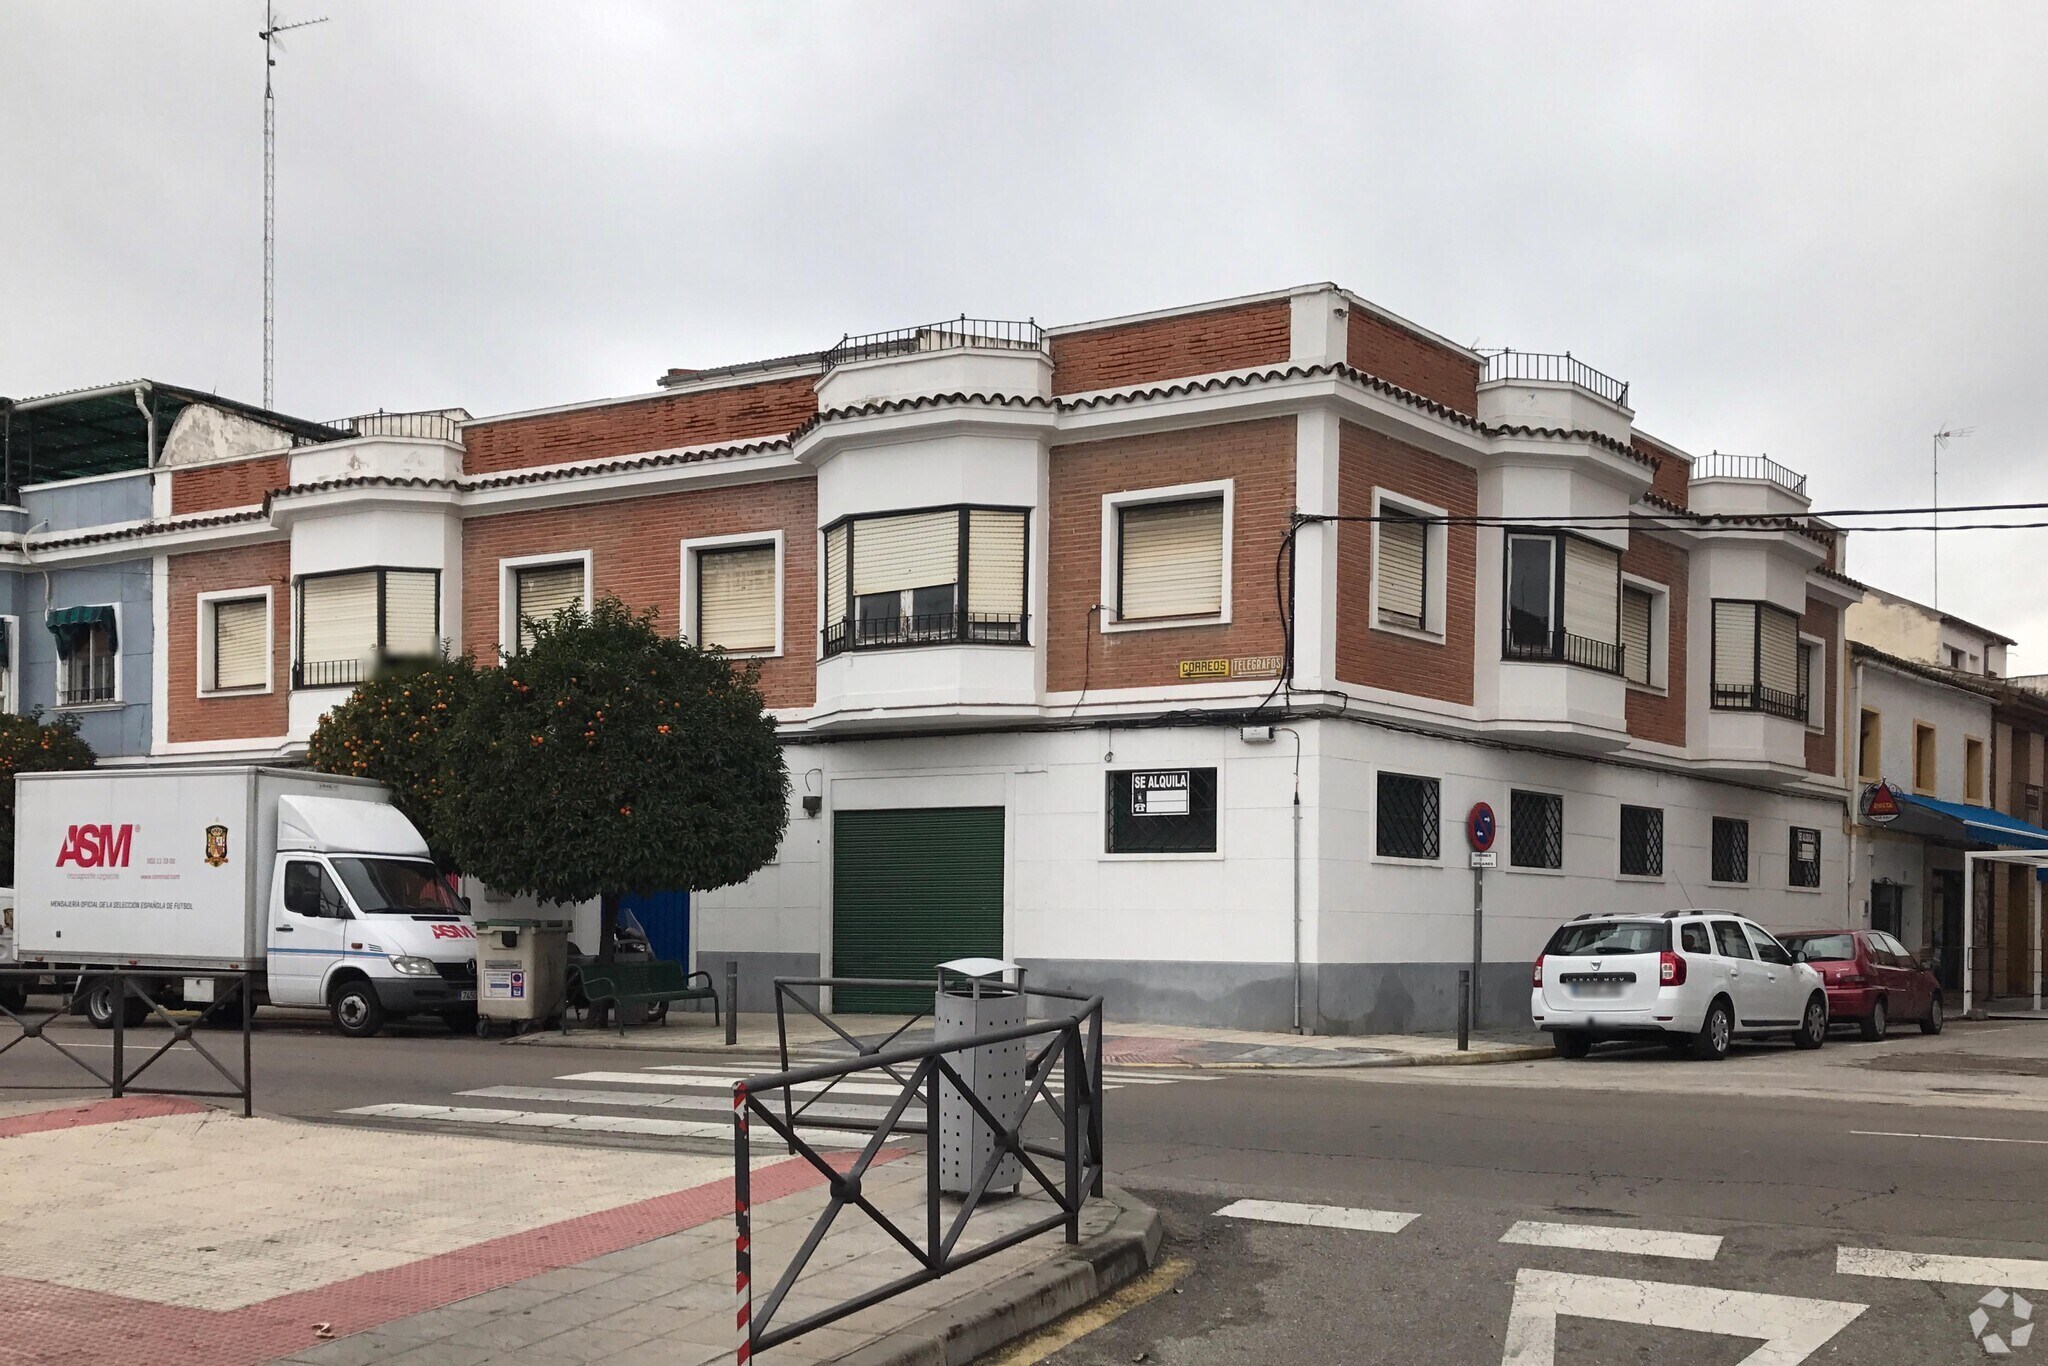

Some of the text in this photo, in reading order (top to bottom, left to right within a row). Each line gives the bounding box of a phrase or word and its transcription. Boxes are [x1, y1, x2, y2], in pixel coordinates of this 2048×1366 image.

[1182, 660, 1226, 672] CORREOS
[1234, 658, 1281, 671] TELEGRAFOS
[1134, 774, 1187, 788] SE ALQUILA
[55, 823, 133, 868] ASM
[99, 901, 106, 909] DE
[106, 901, 113, 909] LA
[166, 902, 173, 910] DE
[431, 924, 477, 939] ASM
